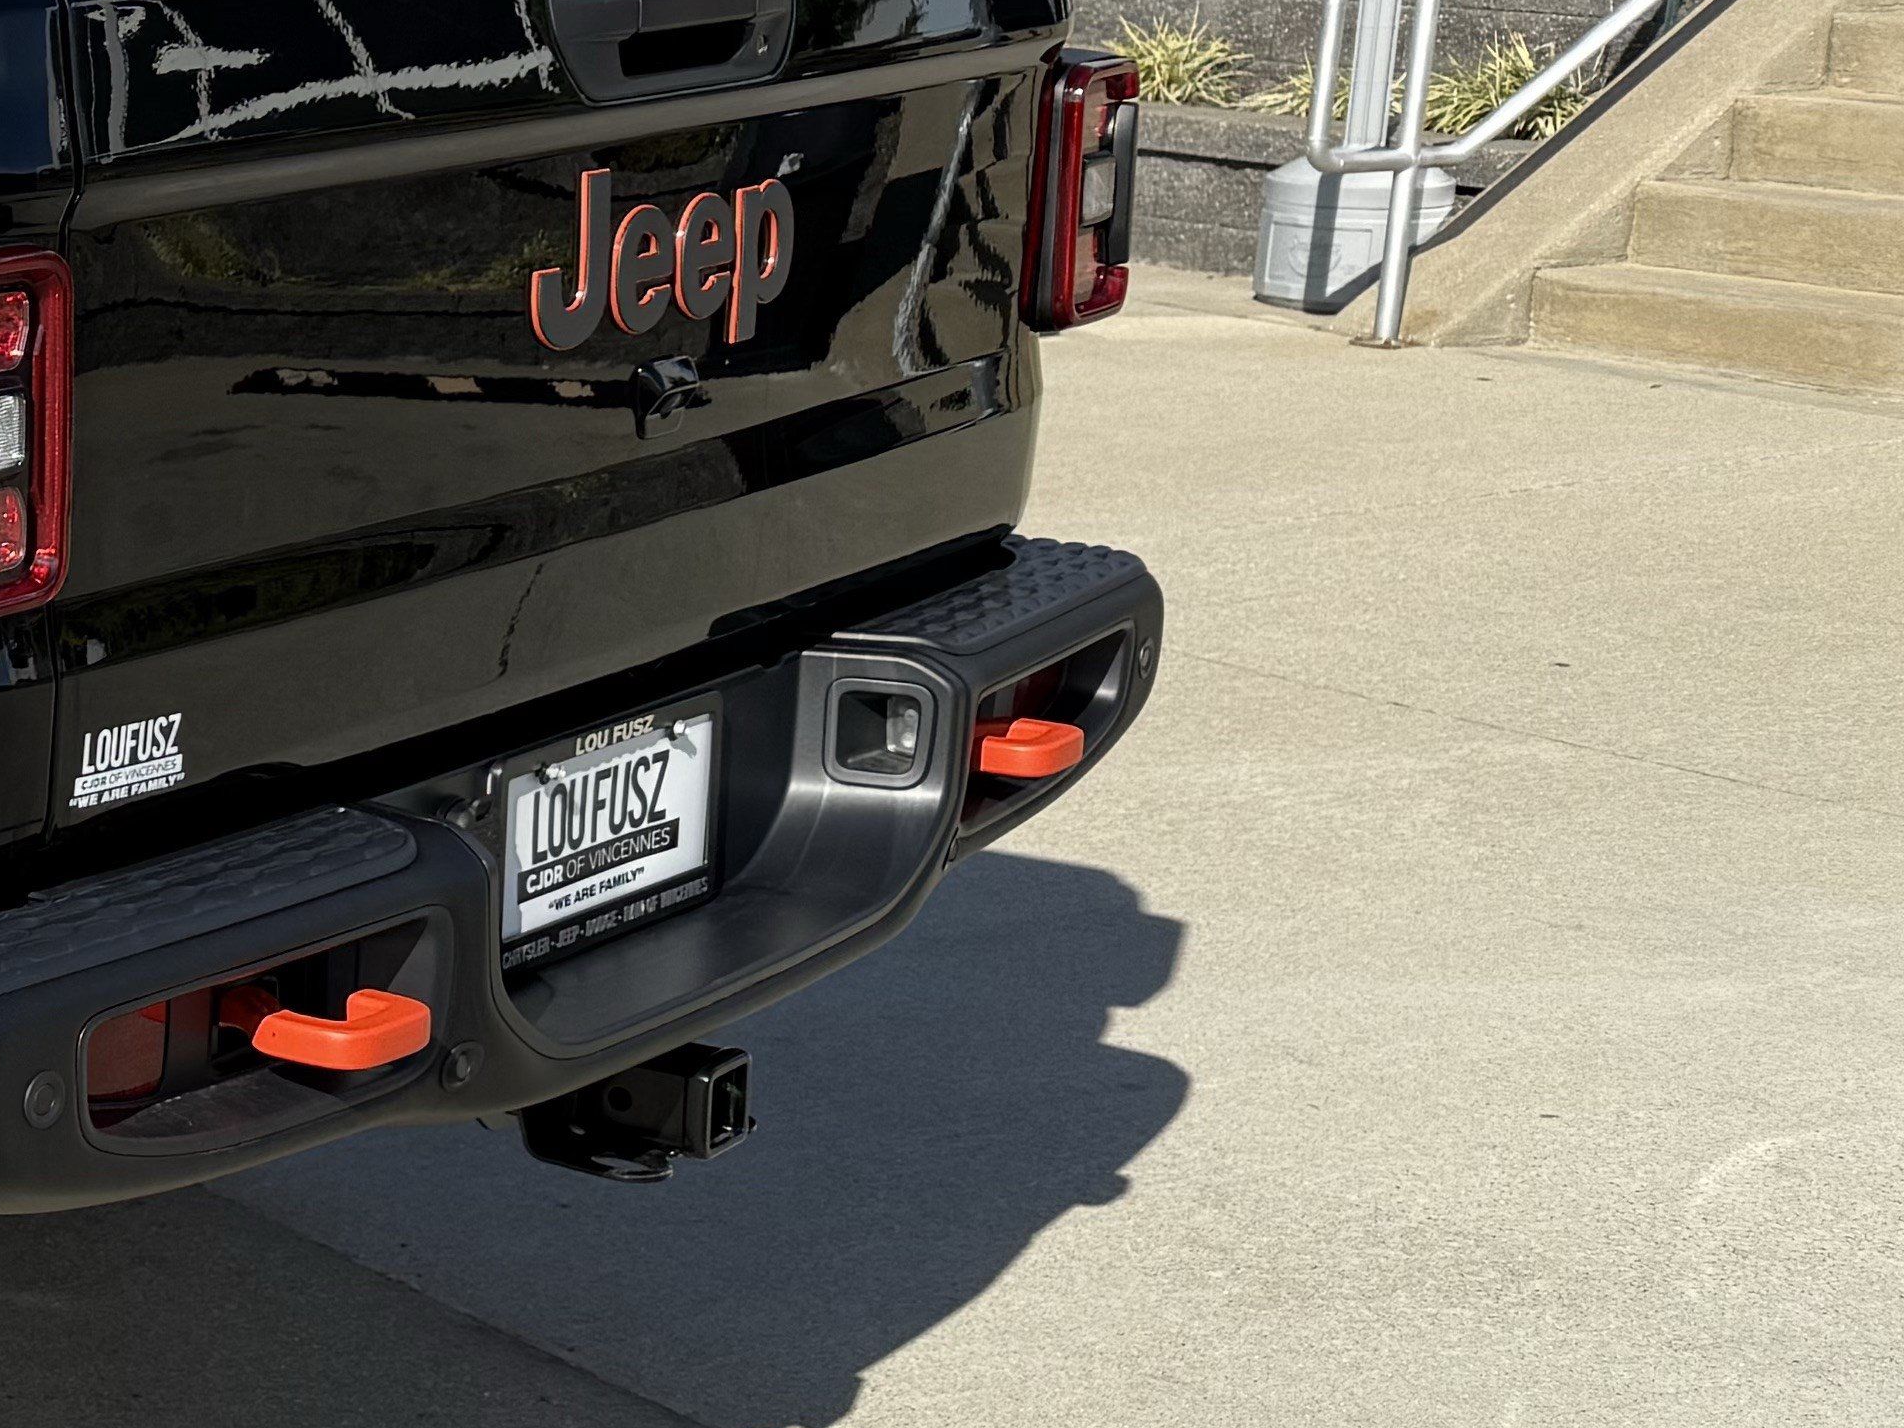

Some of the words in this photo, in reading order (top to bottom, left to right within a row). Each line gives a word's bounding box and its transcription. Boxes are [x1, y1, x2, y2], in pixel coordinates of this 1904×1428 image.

[531, 168, 795, 351] Jeep
[574, 730, 609, 756] LOU
[612, 714, 656, 744] FUSZ
[525, 864, 564, 894] CJDR
[565, 855, 586, 880] OF
[587, 826, 671, 870] VINCENNES
[573, 884, 596, 906] ARE
